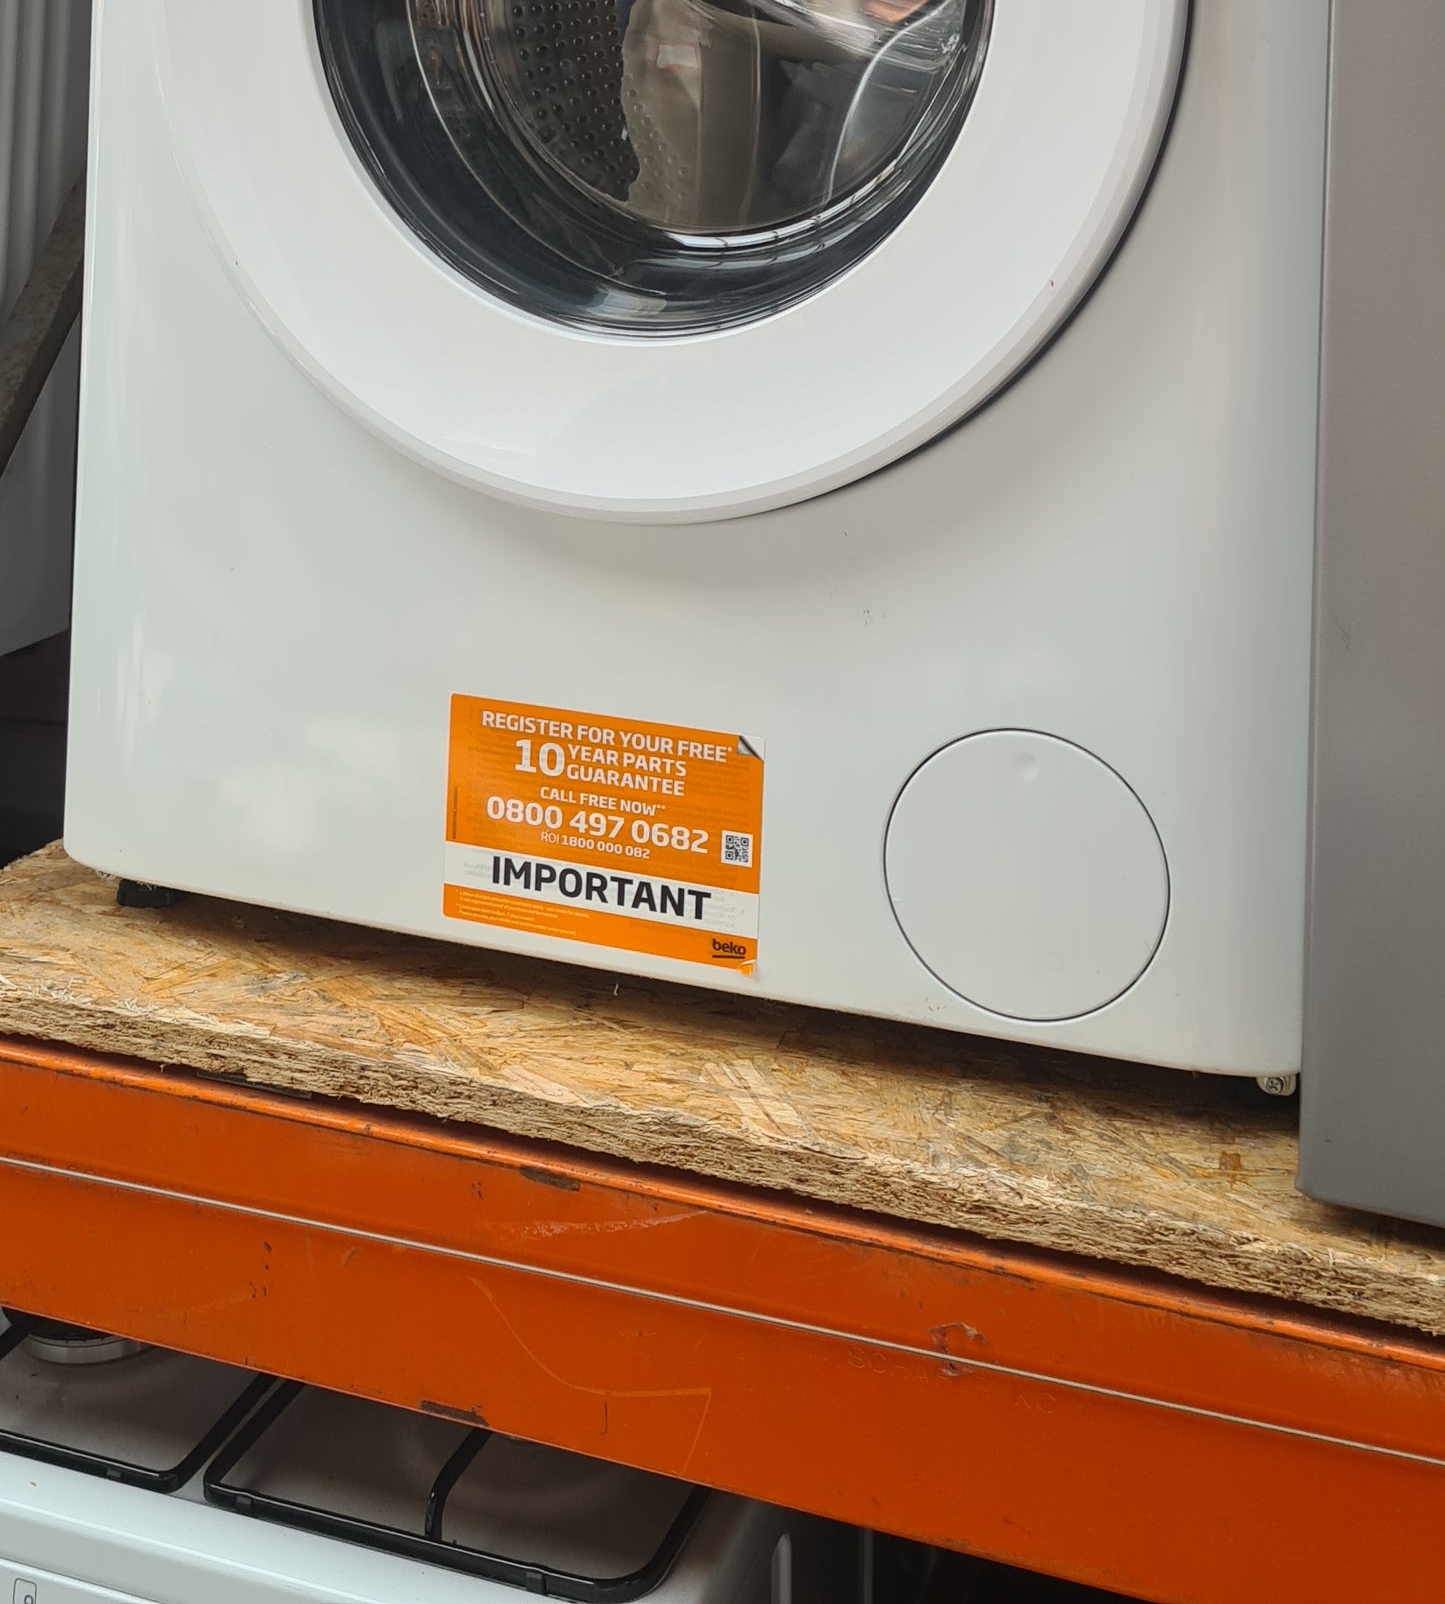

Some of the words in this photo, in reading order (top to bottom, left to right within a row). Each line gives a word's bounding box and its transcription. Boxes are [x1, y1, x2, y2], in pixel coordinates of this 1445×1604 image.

[482, 710, 574, 739] REGISTER
[576, 724, 615, 746] FOR
[619, 730, 674, 755] YOUR
[515, 738, 565, 777] 10
[568, 744, 619, 767] YEAR
[622, 752, 687, 777] PARTS
[566, 763, 685, 797] GUARANTEE
[540, 786, 577, 804] CALL
[580, 793, 617, 810] FREE
[486, 796, 563, 830] 0800
[569, 810, 625, 839] 497
[631, 819, 709, 854] 0682
[540, 831, 560, 845] ROI
[561, 835, 595, 850] 1800
[597, 840, 623, 855] 000
[625, 845, 651, 860] 082
[491, 854, 712, 921] IMPORTANT
[711, 937, 748, 957] beko
